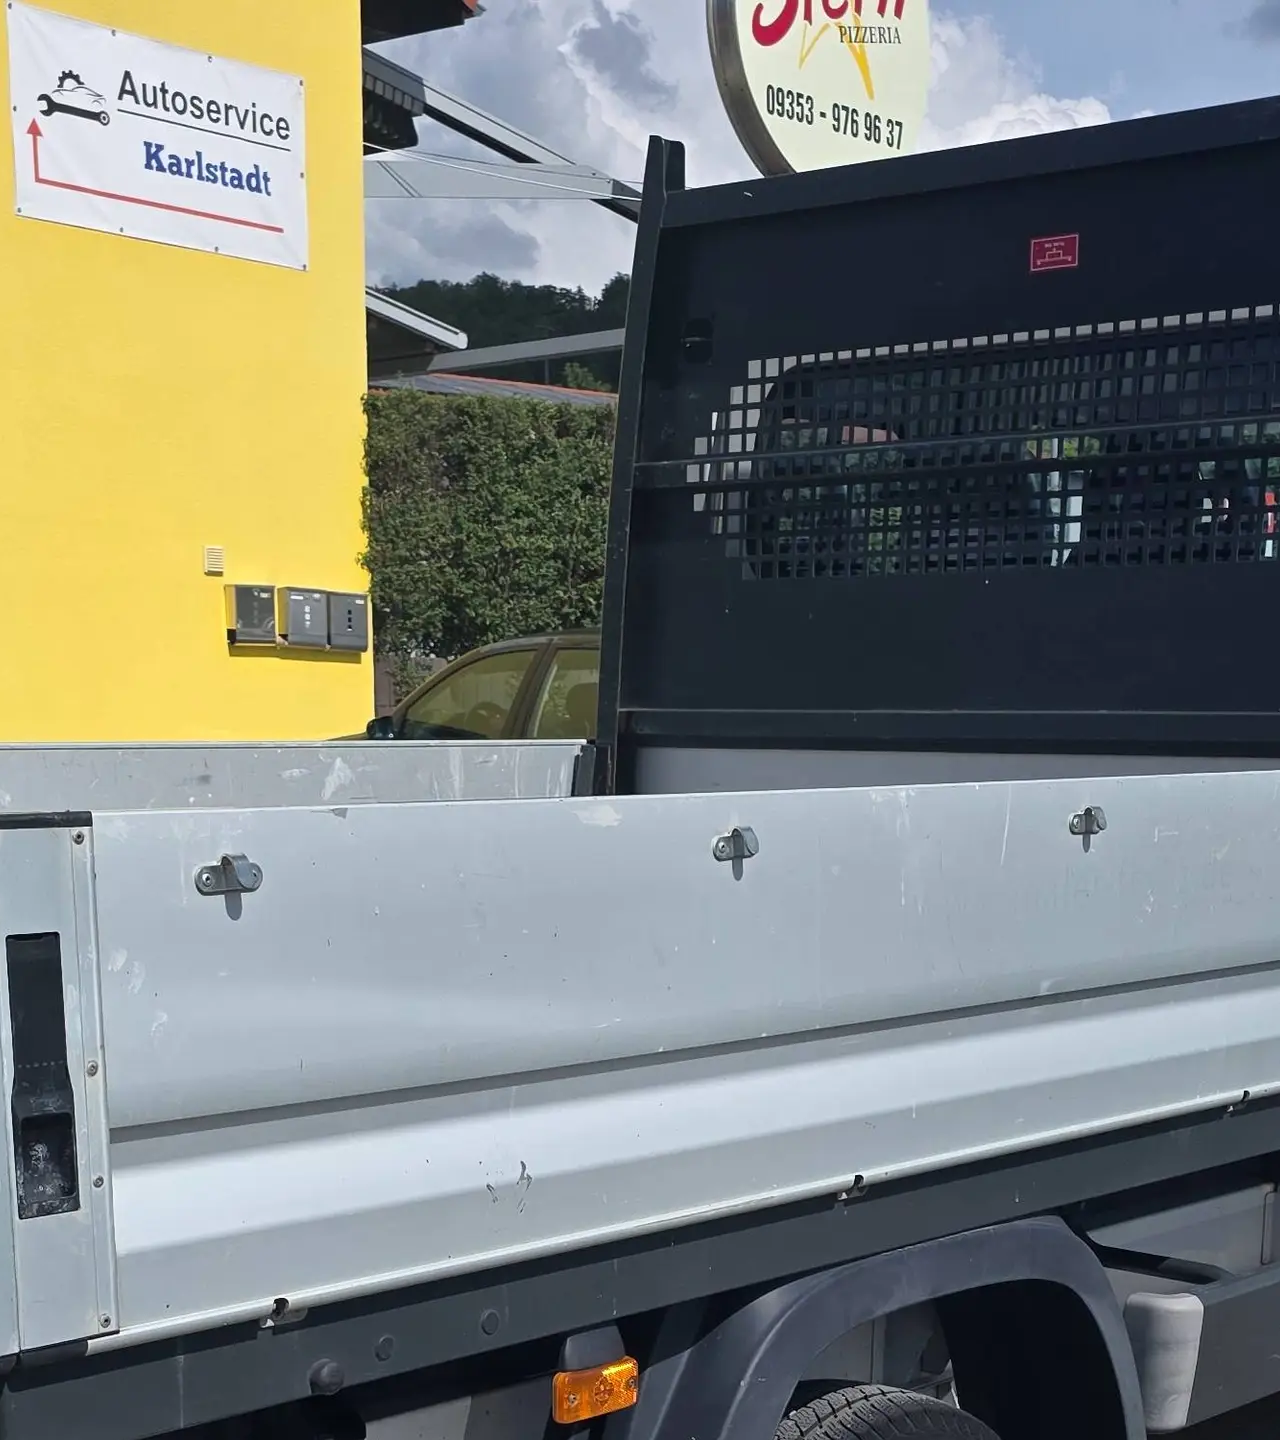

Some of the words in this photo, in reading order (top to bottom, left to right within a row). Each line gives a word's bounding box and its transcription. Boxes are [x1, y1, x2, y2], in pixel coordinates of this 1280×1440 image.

[839, 25, 902, 44] PIZZERIA
[117, 69, 291, 141] Autoservice
[766, 84, 814, 126] 09353
[832, 103, 859, 138] 976
[863, 112, 881, 144] 96
[886, 119, 903, 150] 37
[143, 141, 272, 197] Karlstadt
